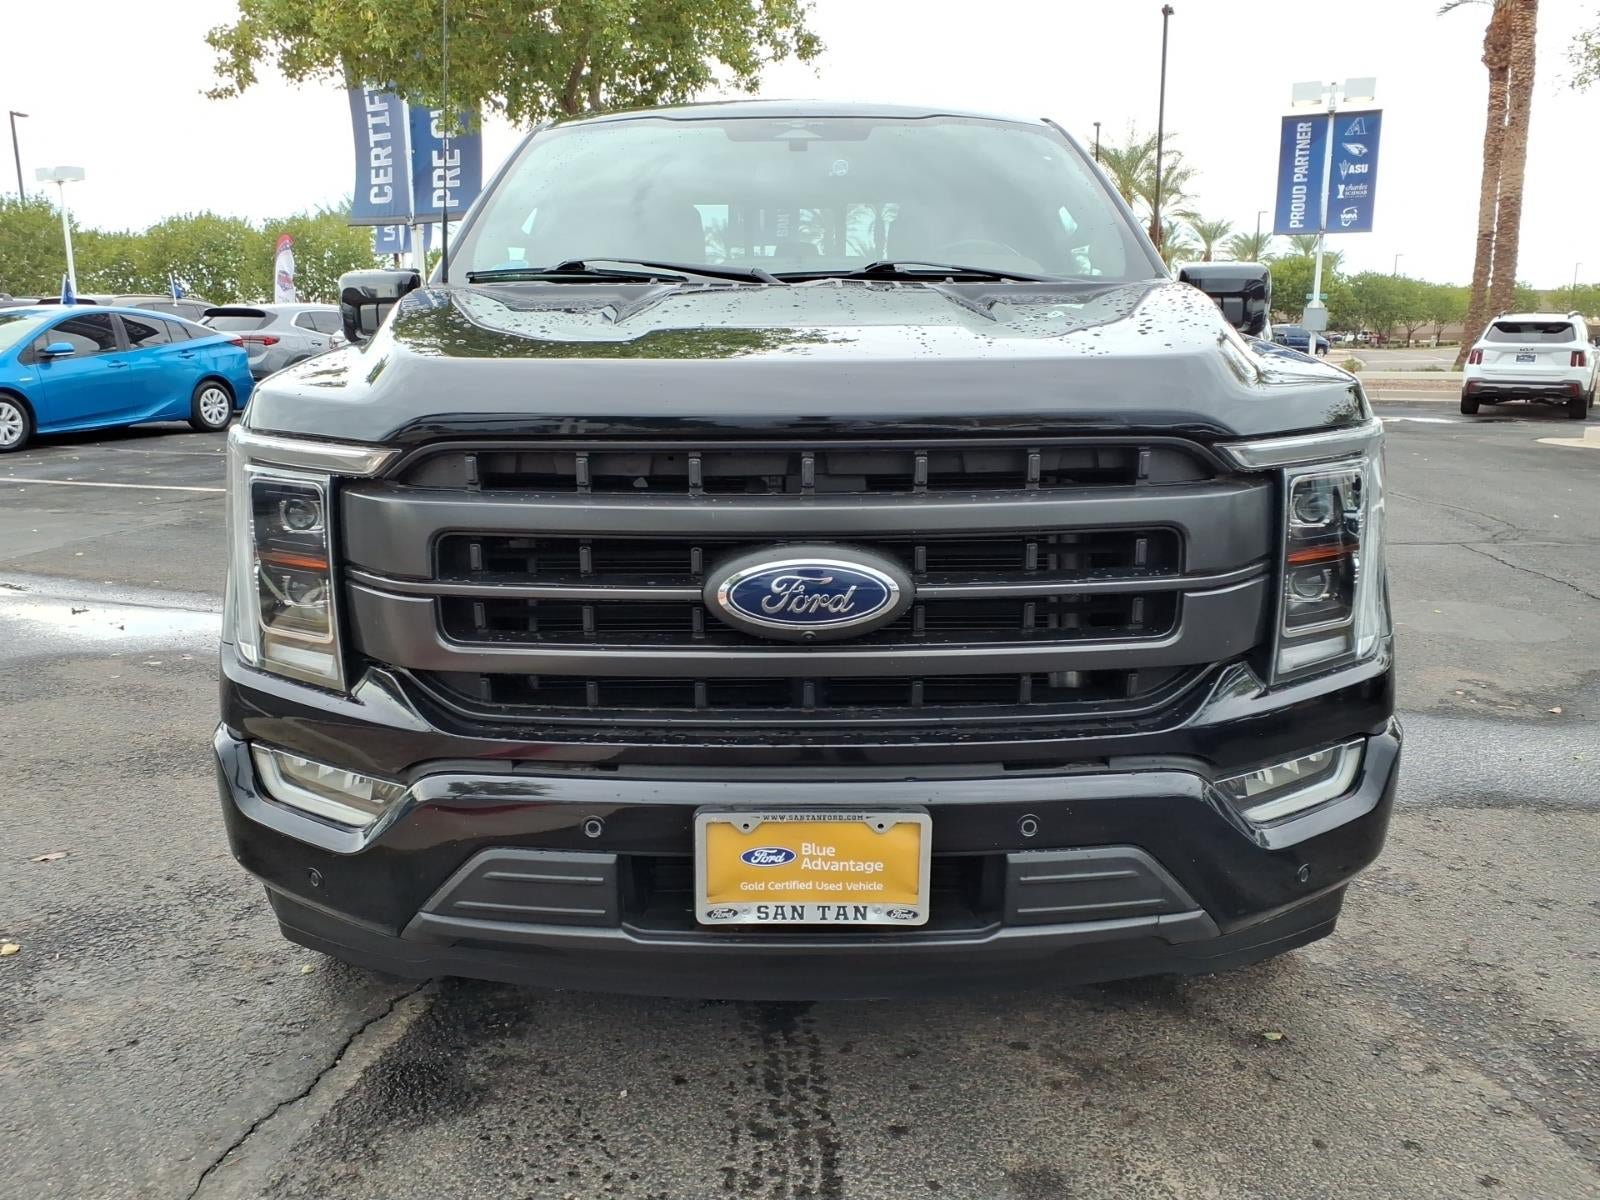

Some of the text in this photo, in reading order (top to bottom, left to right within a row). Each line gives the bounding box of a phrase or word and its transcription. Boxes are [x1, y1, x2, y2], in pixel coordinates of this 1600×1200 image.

[1290, 121, 1312, 228] PROUD PARTNER
[1349, 164, 1369, 174] ASU
[761, 575, 857, 614] Ford
[750, 842, 836, 864] Ford Blue
[801, 857, 884, 874] Advantage
[740, 880, 884, 891] Gold Certified Used Vehicle
[710, 904, 915, 921] Ford SAN TAN Ford
